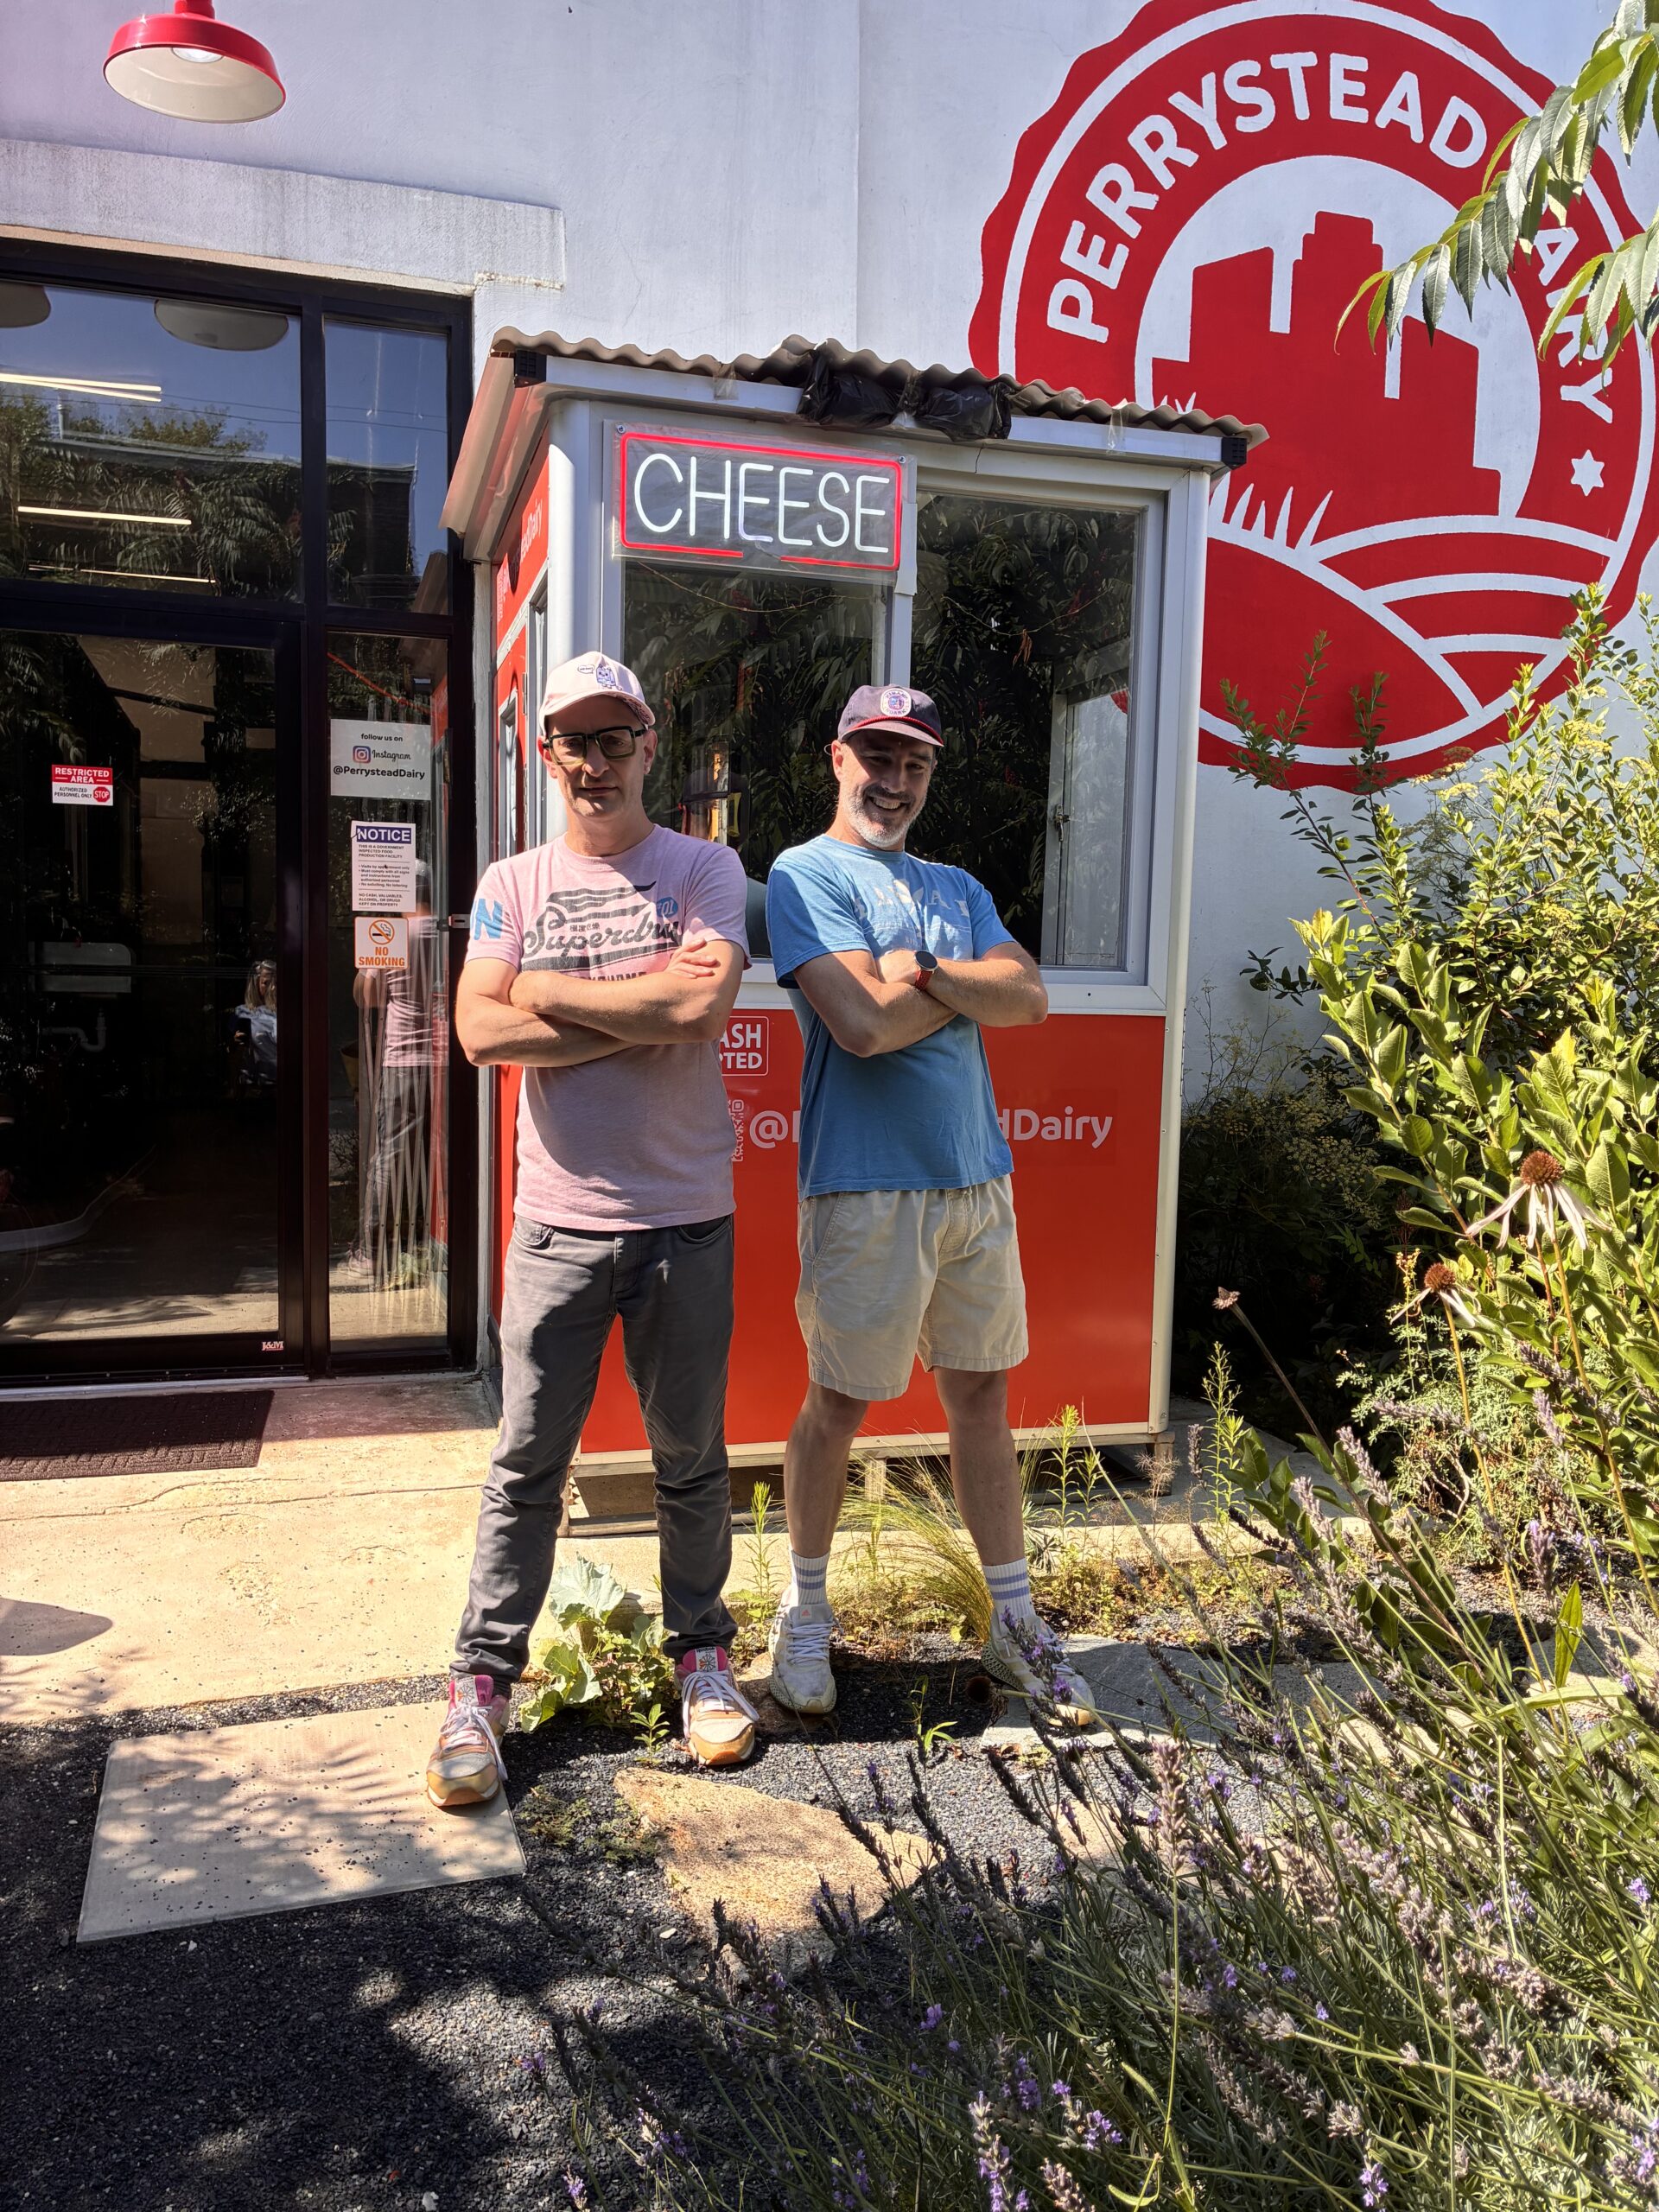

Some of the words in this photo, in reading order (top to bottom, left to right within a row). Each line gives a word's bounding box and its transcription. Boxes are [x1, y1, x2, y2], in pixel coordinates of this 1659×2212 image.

[1046, 51, 1487, 343] PERRYSTEAD
[1534, 195, 1612, 424] ARY
[633, 452, 890, 553] CHEESE
[372, 750, 411, 762] Instagram
[55, 767, 109, 777] RESTRICTED
[334, 766, 425, 780] @PerrysteadDairy
[94, 790, 109, 799] STOP
[357, 829, 410, 842] NOTICE
[522, 906, 683, 958] Superdry
[375, 947, 388, 955] NO
[359, 957, 405, 966] SMOKING
[720, 1023, 762, 1048] ASH
[719, 1052, 763, 1069] TED
